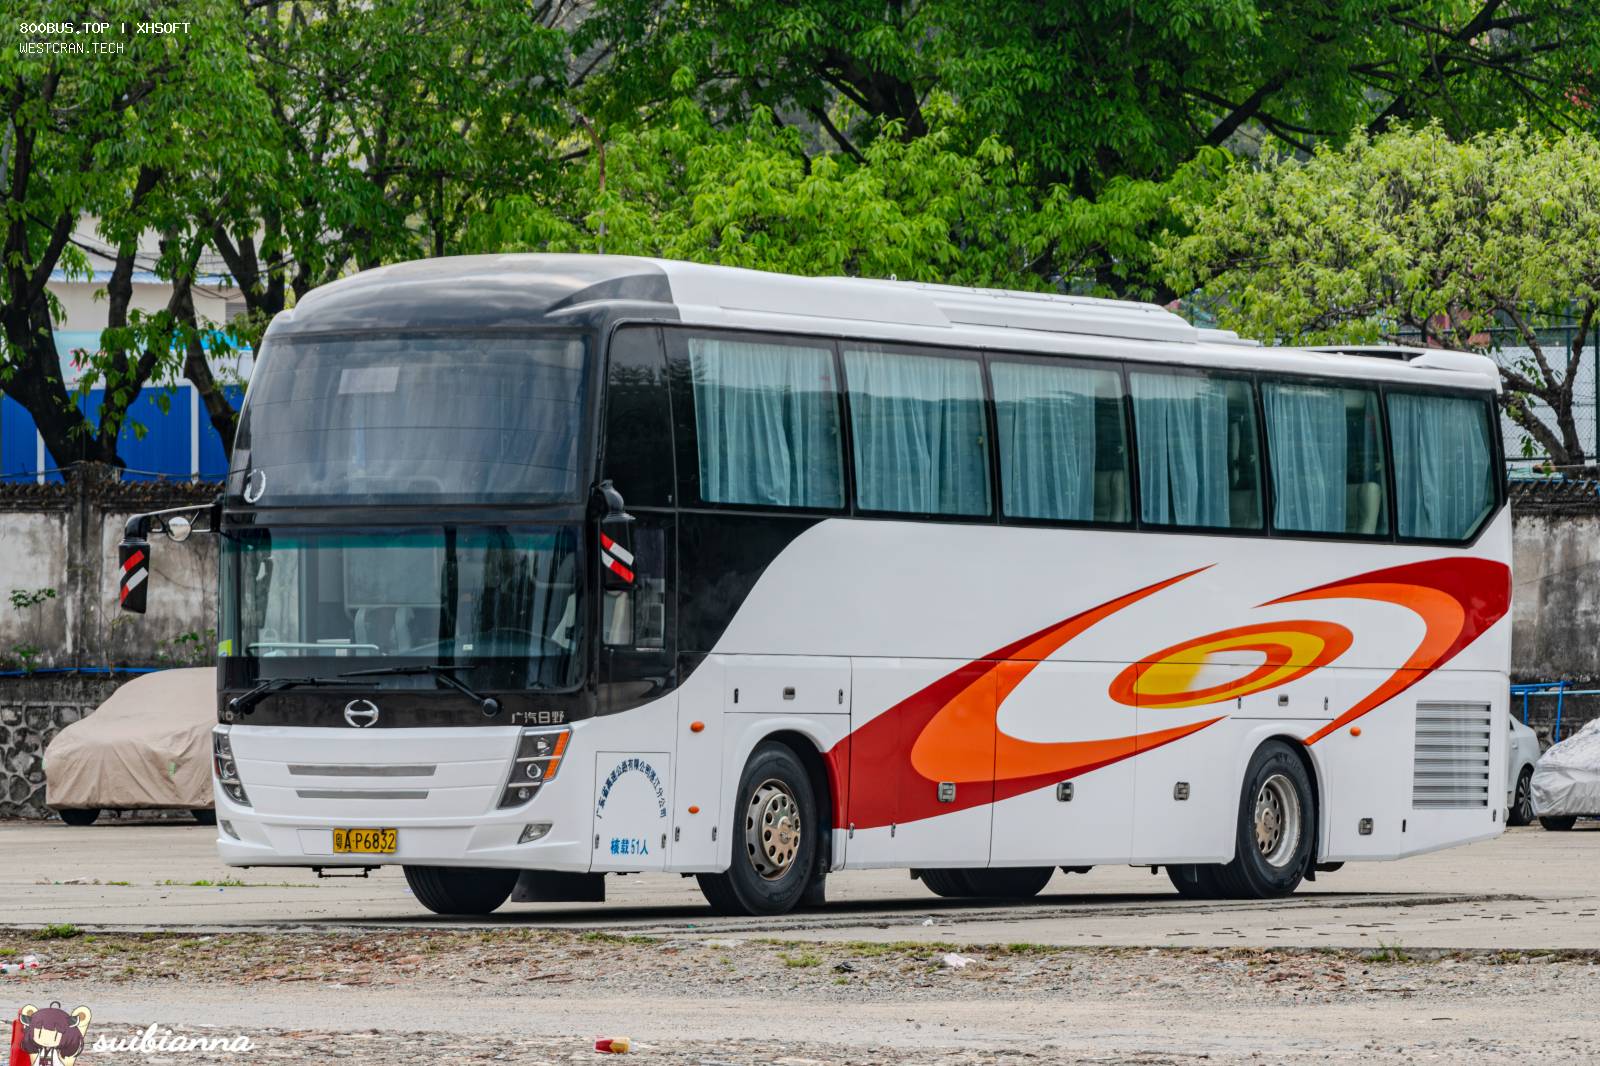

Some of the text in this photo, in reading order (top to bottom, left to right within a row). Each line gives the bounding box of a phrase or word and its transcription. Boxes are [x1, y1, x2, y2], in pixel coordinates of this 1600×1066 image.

[511, 711, 565, 724] 广汽日野
[610, 838, 649, 855] 核载51人
